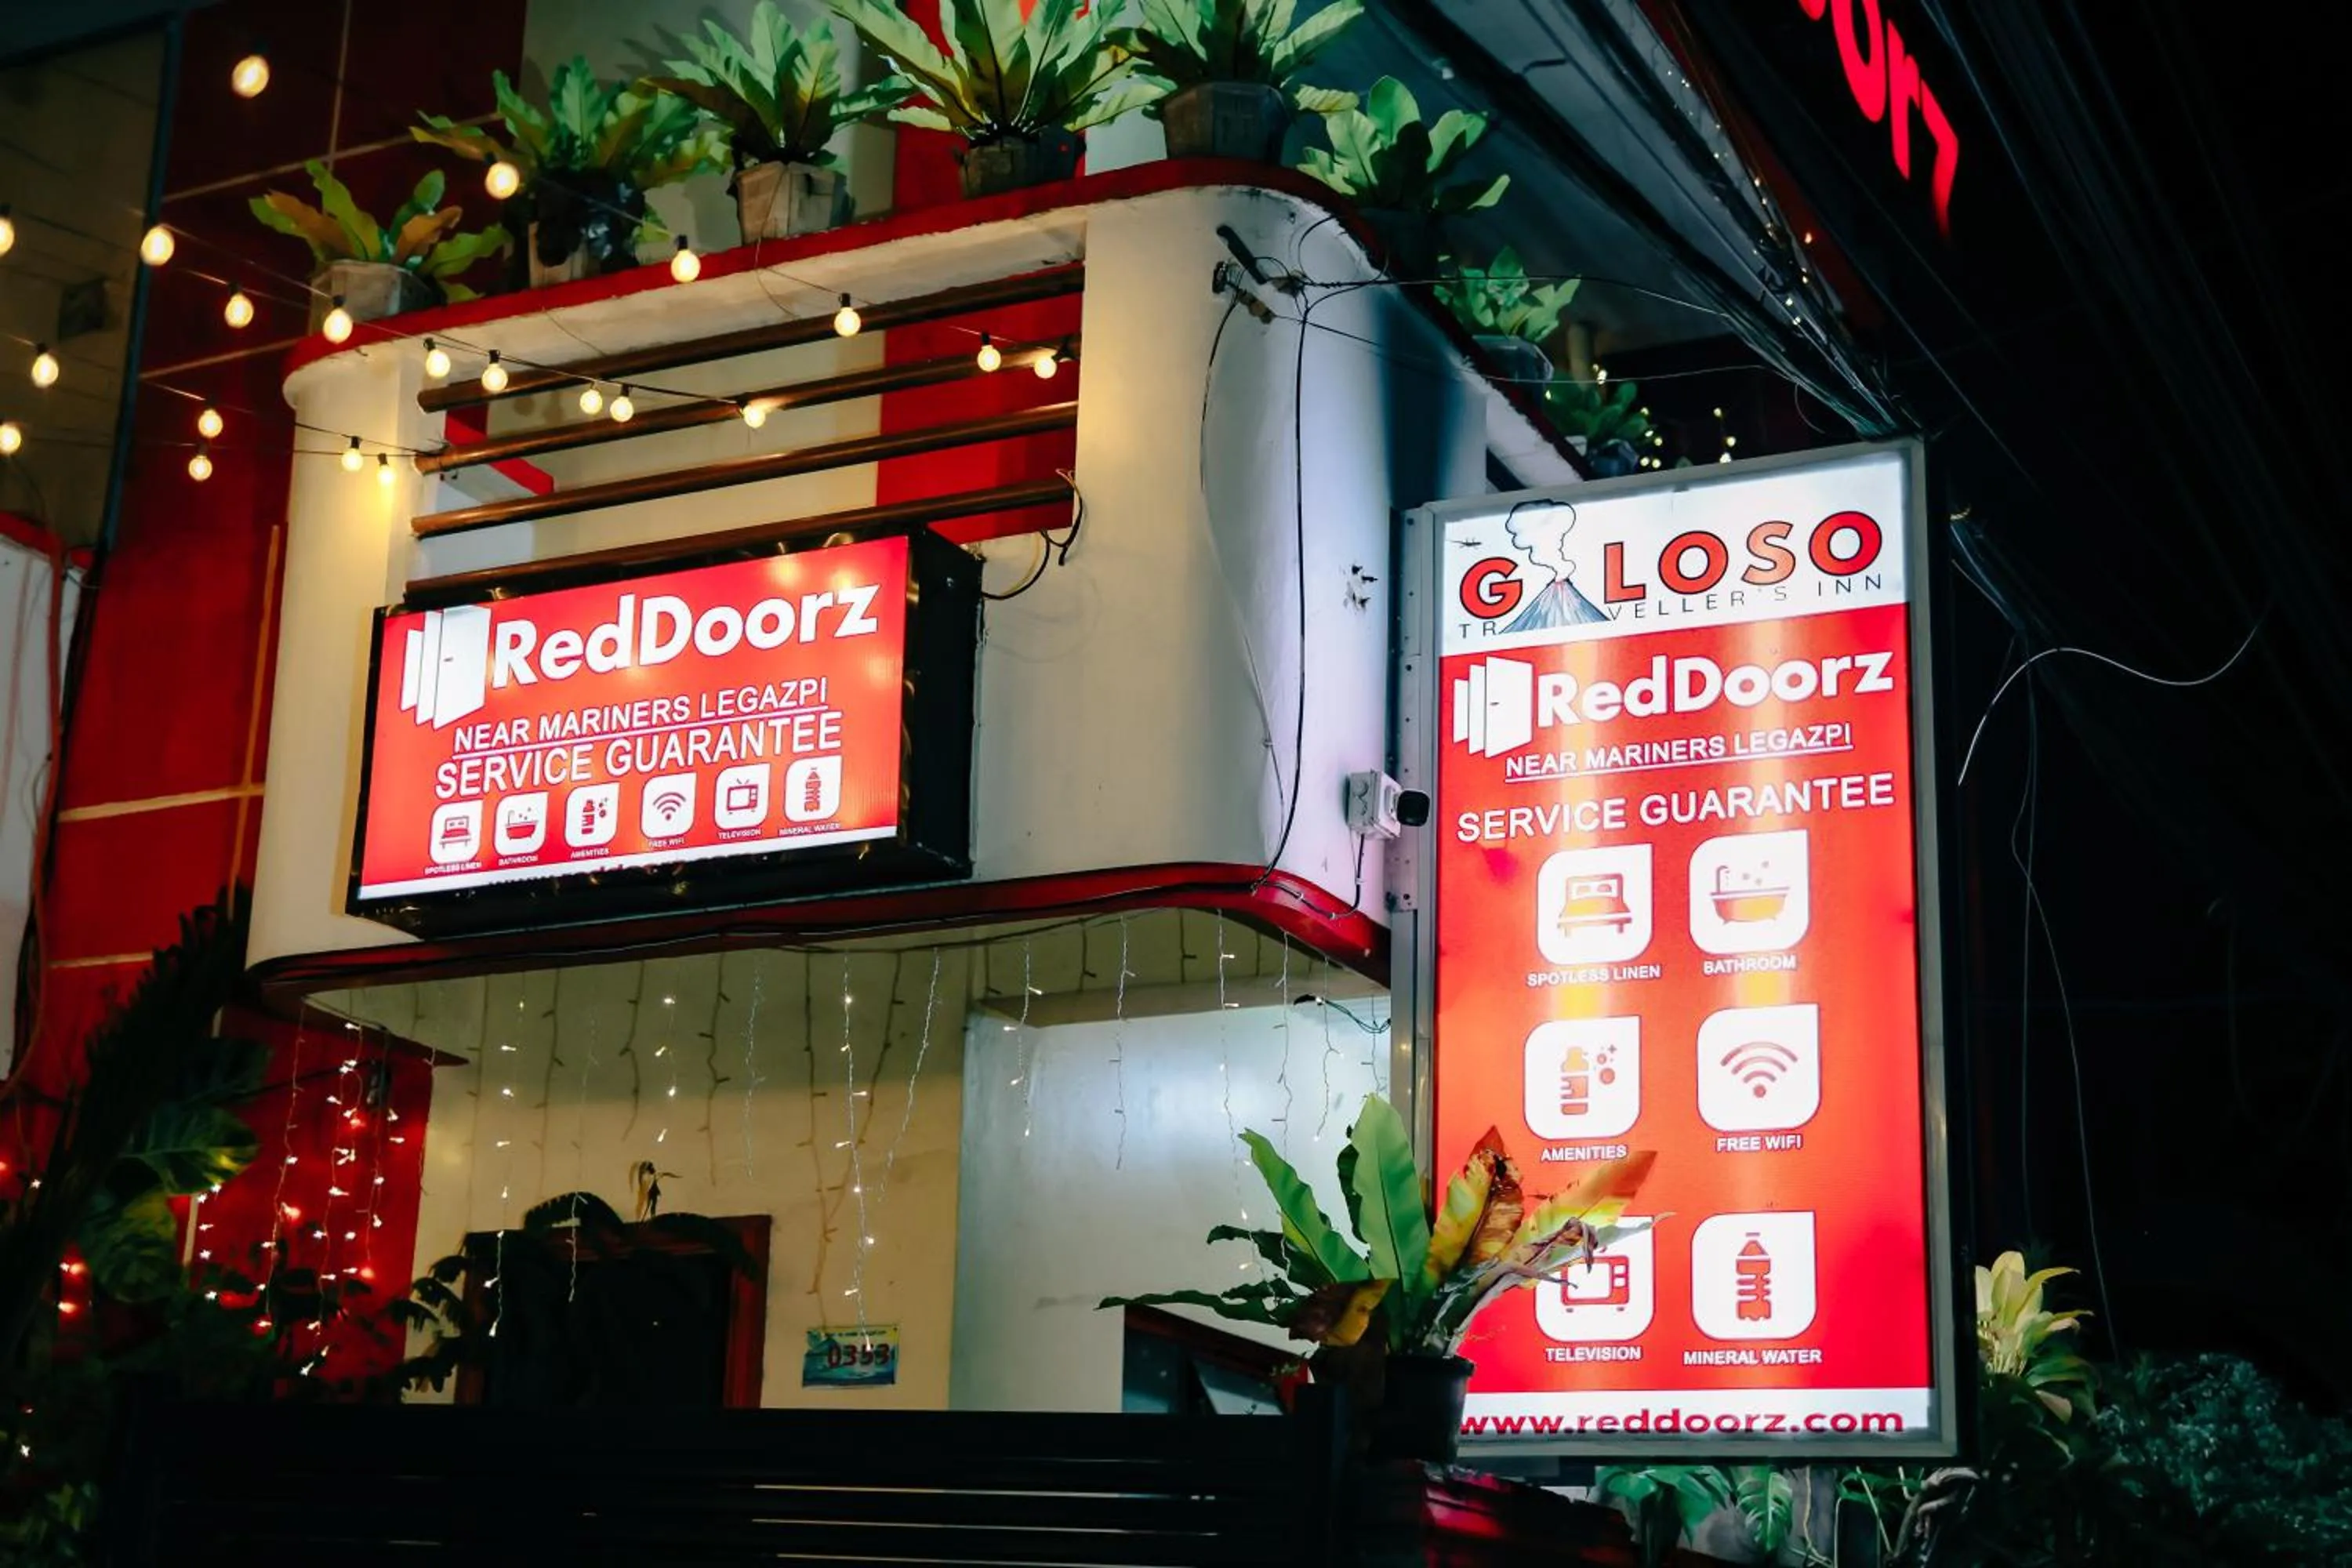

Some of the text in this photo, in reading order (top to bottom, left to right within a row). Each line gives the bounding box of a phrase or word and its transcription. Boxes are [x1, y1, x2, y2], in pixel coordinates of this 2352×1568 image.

[1458, 510, 1882, 619] GLOSO
[1818, 573, 1881, 597] INN
[491, 583, 879, 689] RedDoorz
[1537, 651, 1894, 728] RedDoorz
[453, 677, 828, 753] NEAR MARINERS LEGAZPI
[434, 711, 842, 800] SERVICE GUARANTEE
[1504, 723, 1851, 779] NEAR MARINERS LEGAZPI
[1457, 773, 1894, 843] SERVICE GUARANTEE
[1527, 964, 1661, 986] SPOTLESS LINEN
[1702, 955, 1797, 975] BATHROOM
[1541, 1144, 1627, 1162] AMENITIES
[1715, 1134, 1802, 1152] FREE WIFI
[1544, 1345, 1641, 1362] TELEVISION
[1682, 1348, 1823, 1366] MINERAL WATER
[1460, 1408, 1904, 1436] www.reddoorz.com
